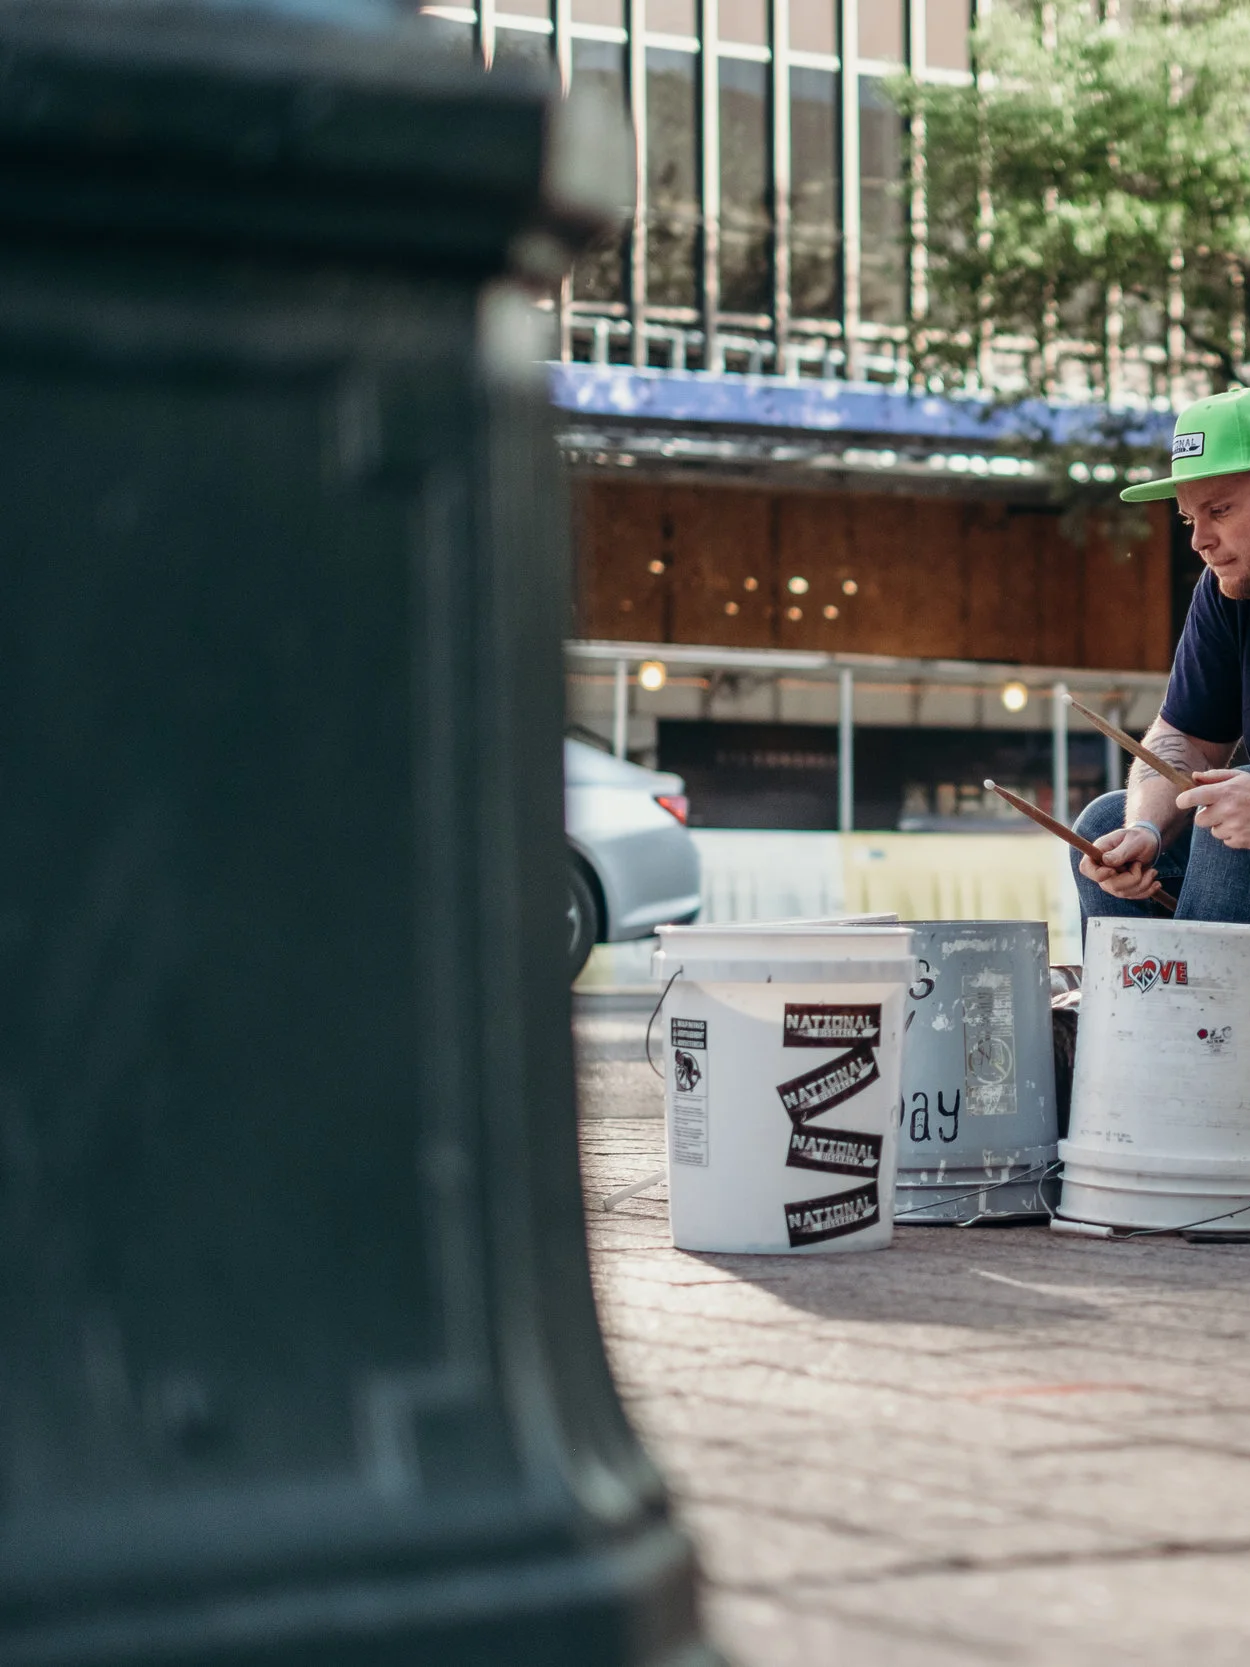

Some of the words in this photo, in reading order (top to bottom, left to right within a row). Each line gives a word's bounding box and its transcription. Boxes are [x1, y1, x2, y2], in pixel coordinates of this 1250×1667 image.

[786, 1014, 873, 1029] NATIONAL
[783, 1057, 868, 1109] NATIONAL
[900, 1089, 961, 1143] ay
[792, 1134, 874, 1160] NATIONAL
[788, 1196, 872, 1229] NATIONAL
